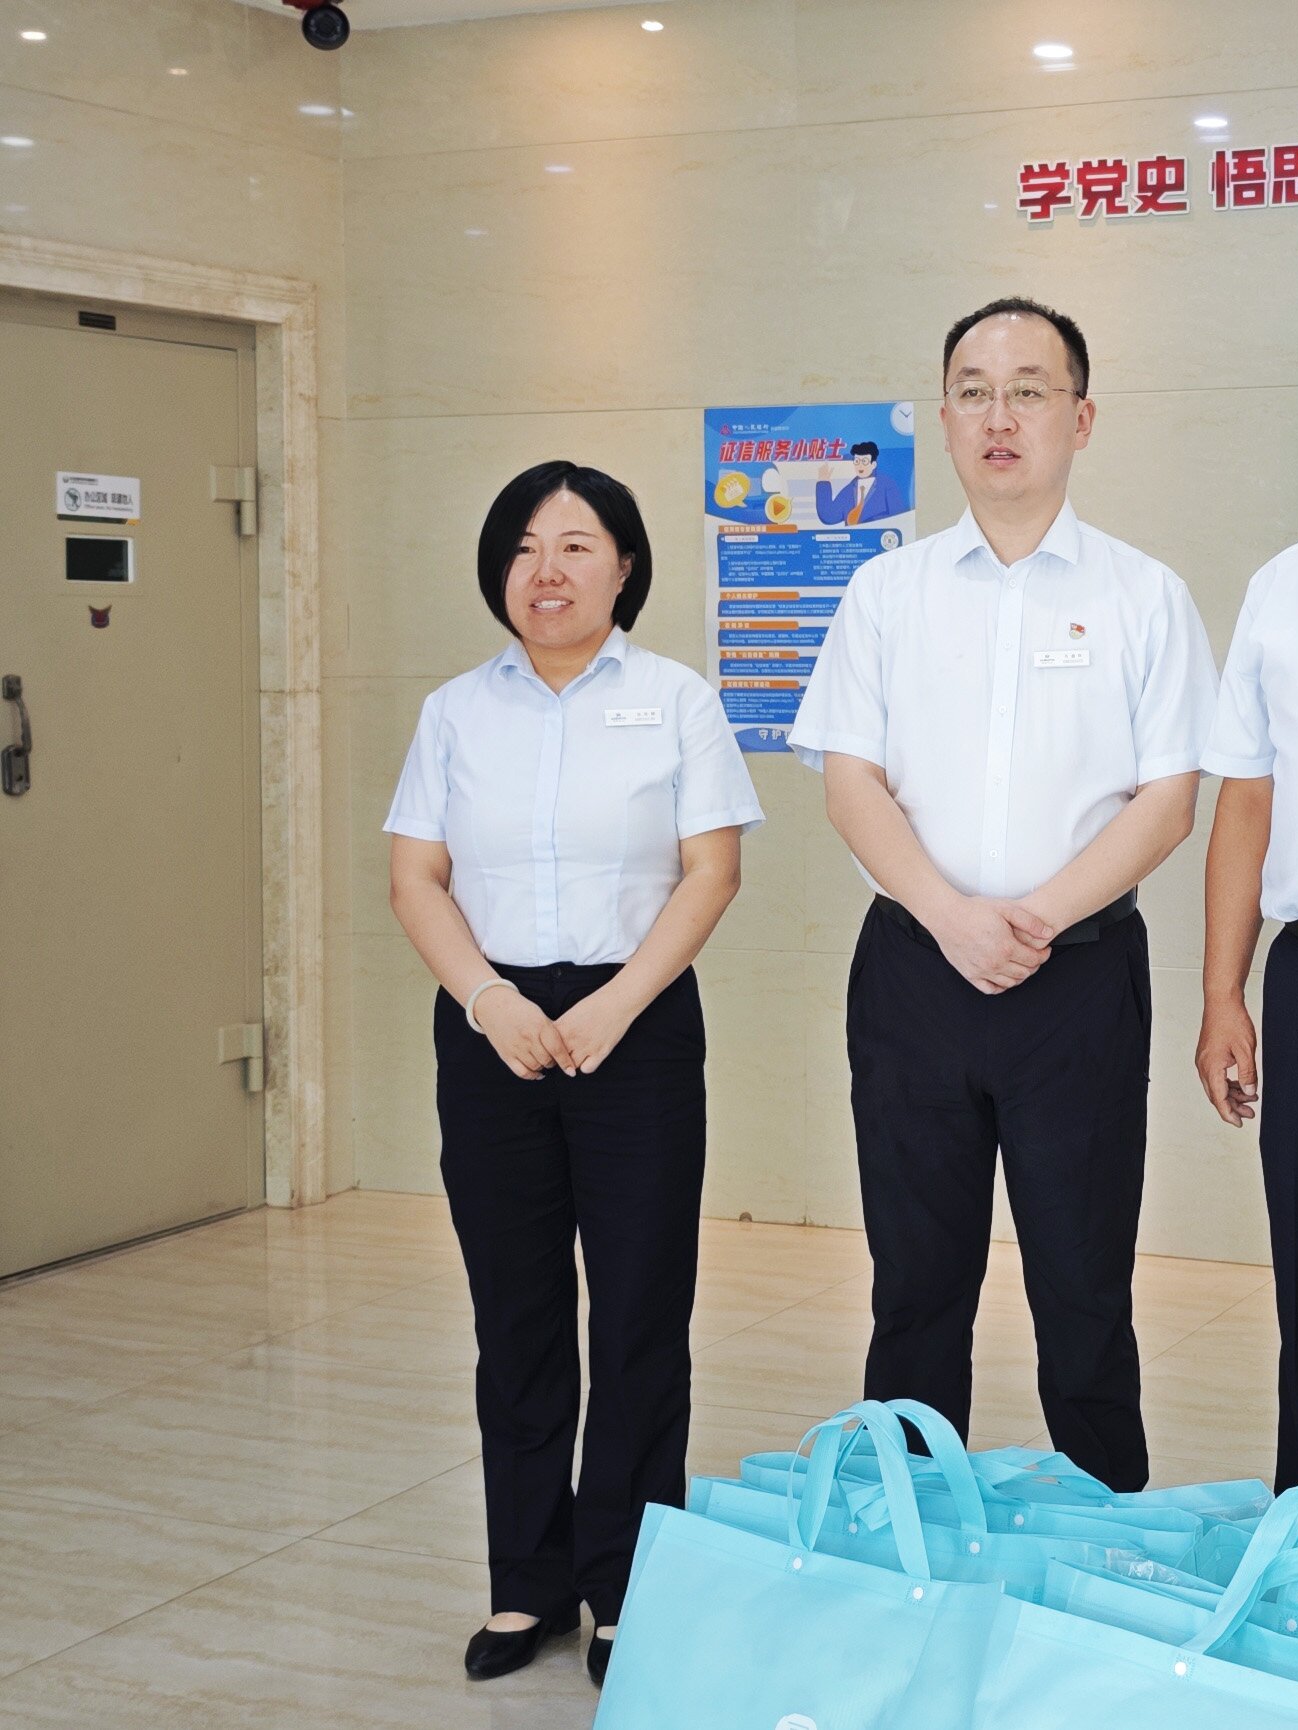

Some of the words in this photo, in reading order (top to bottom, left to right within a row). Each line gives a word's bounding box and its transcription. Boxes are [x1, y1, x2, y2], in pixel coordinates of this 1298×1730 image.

[1018, 155, 1188, 220] 学党史
[719, 437, 847, 462] 征信服务小贴士
